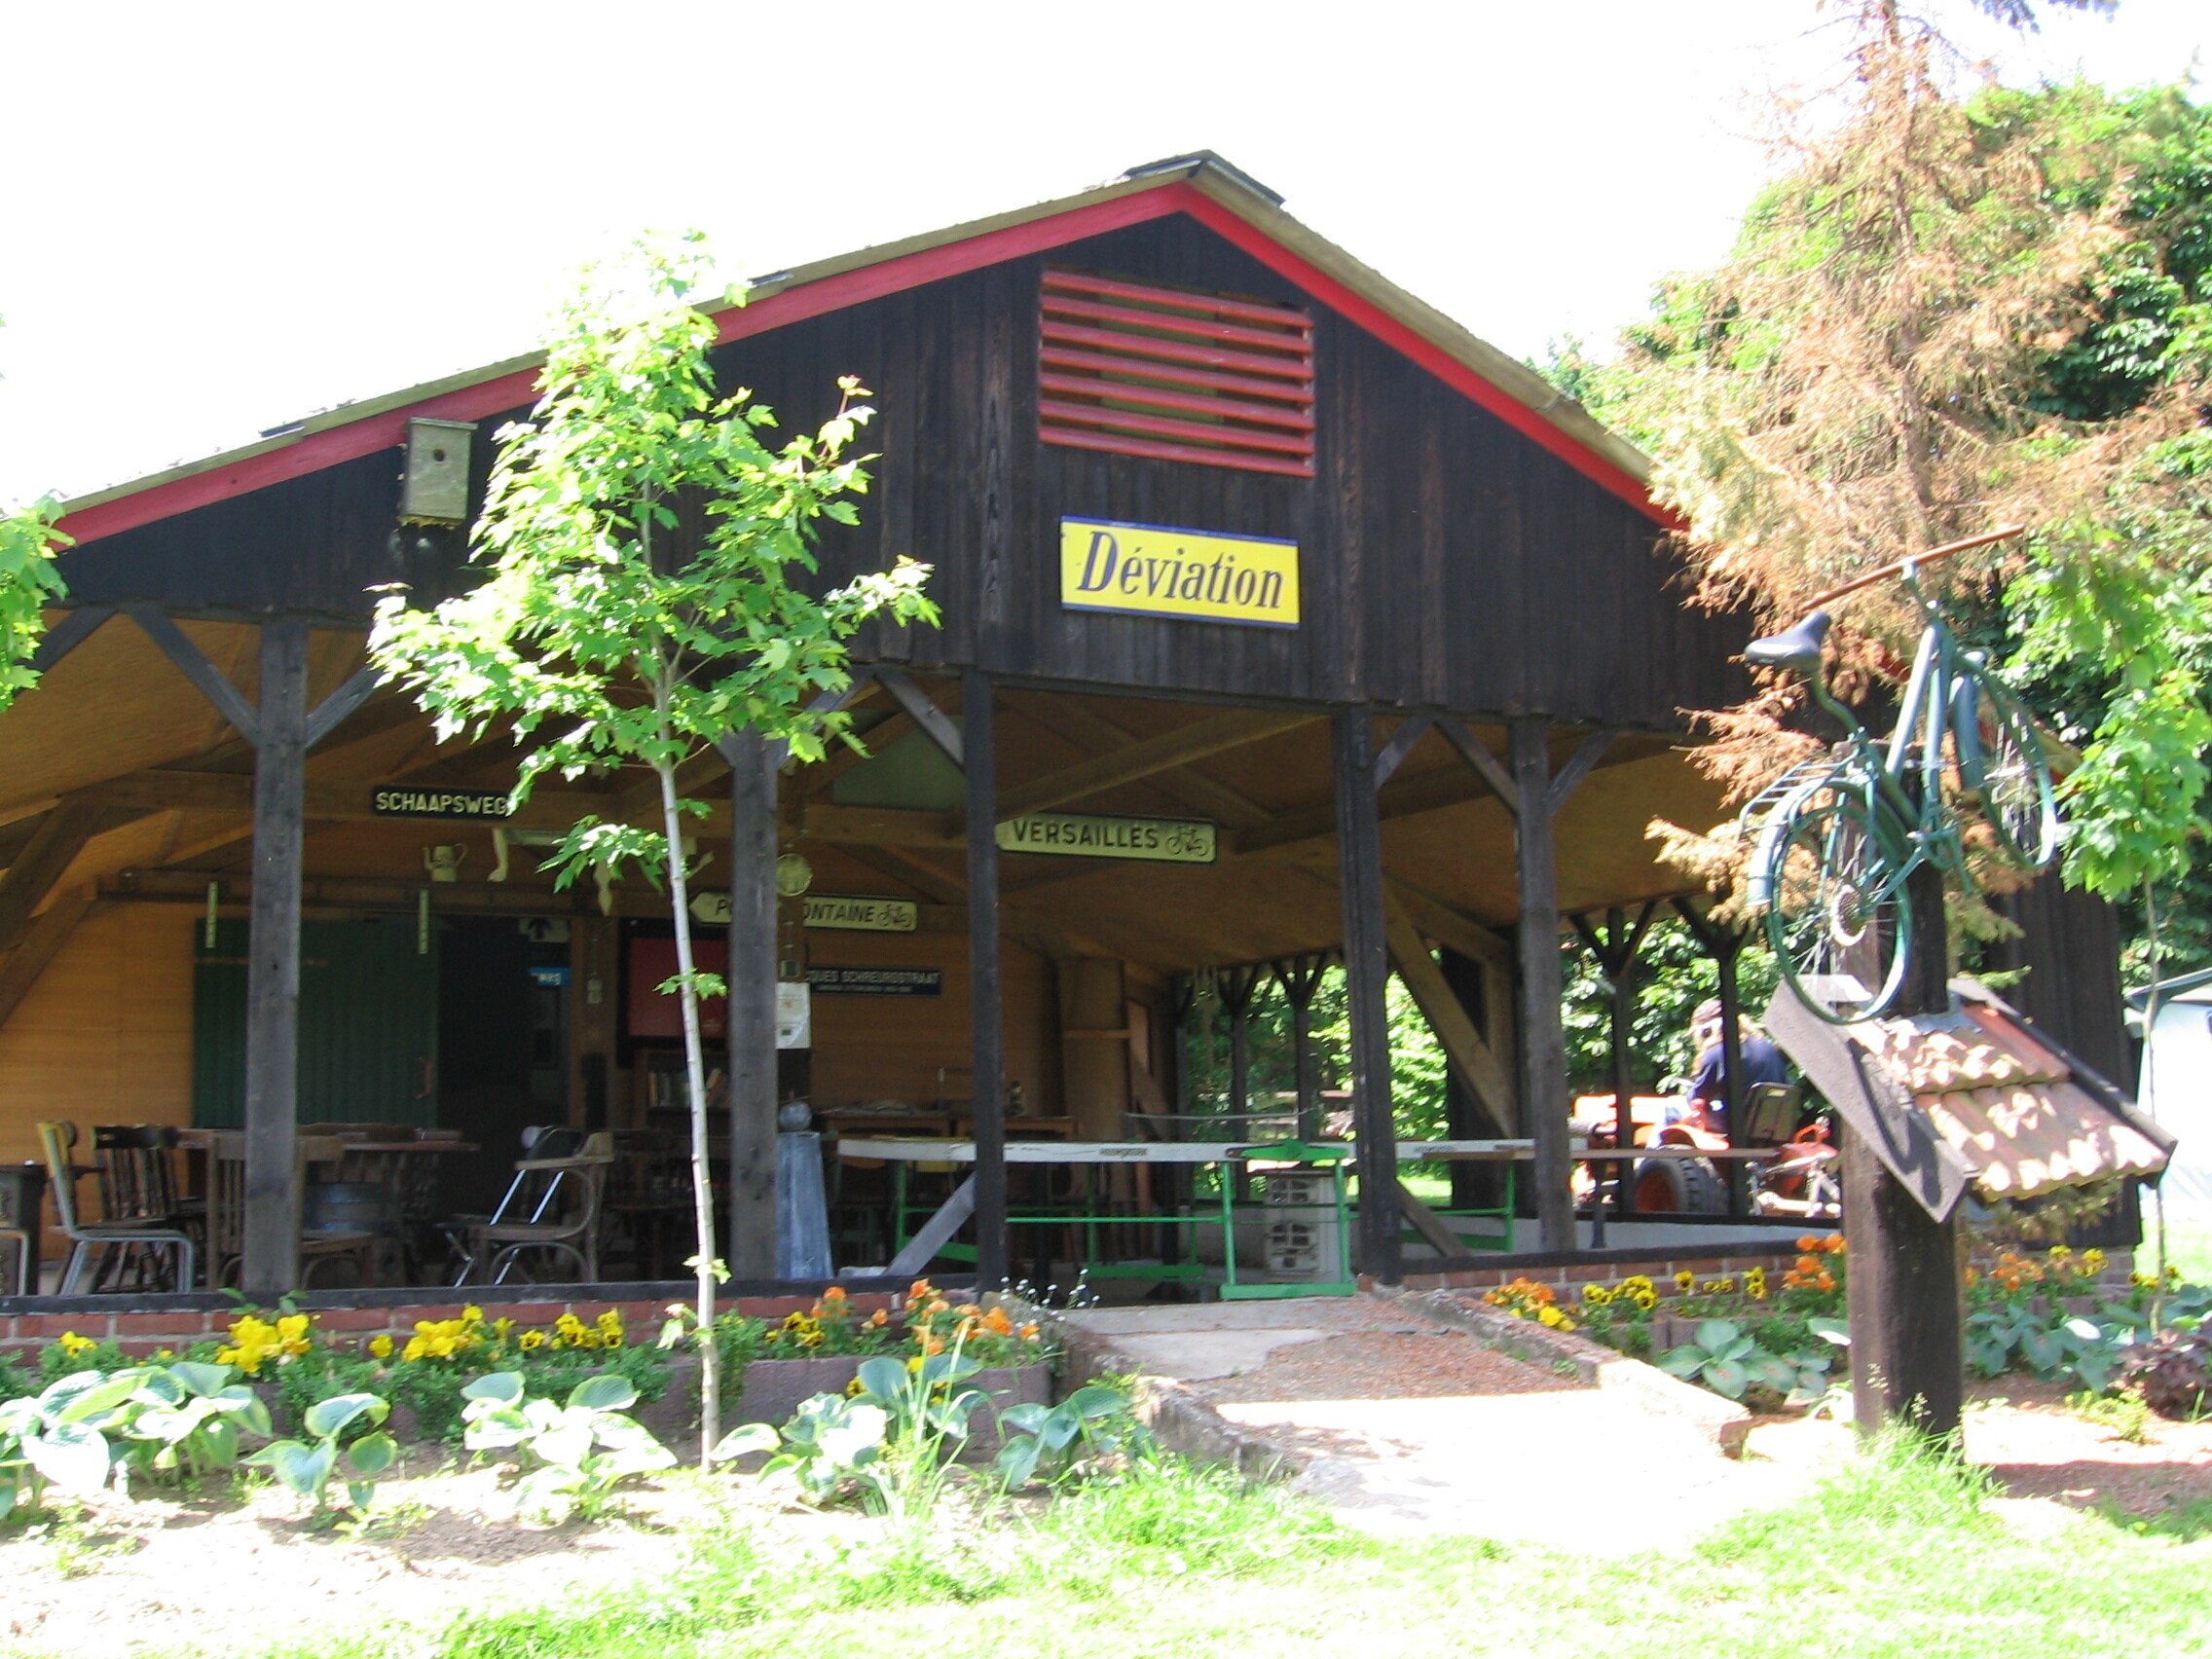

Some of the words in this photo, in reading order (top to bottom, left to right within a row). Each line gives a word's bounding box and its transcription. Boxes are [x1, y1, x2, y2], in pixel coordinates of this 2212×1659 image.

[1076, 531, 1283, 609] Déviation
[375, 791, 507, 815] SCHAAPSWEG
[1013, 820, 1159, 849] VERSAILLES
